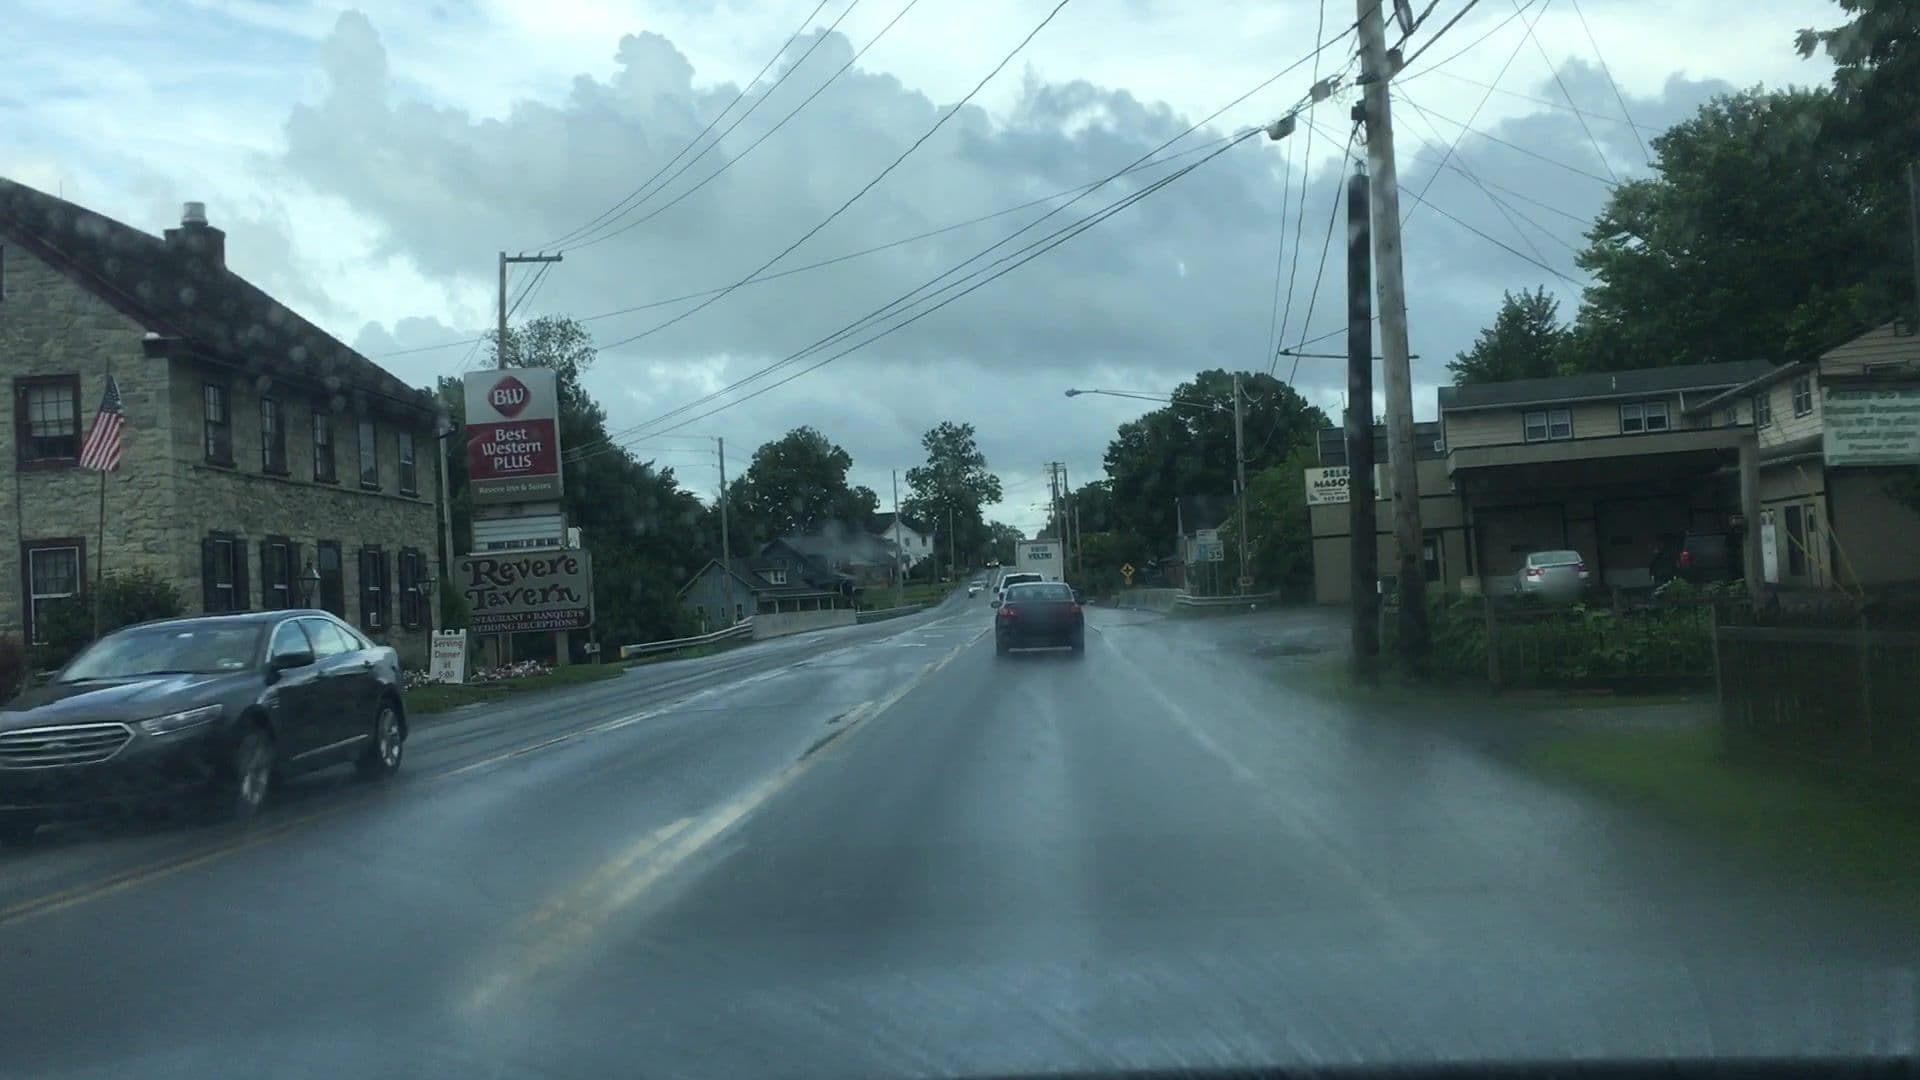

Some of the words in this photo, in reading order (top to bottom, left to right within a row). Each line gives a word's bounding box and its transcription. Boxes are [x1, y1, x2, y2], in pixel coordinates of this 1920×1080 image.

[494, 388, 524, 406] BW
[495, 428, 528, 441] Best
[481, 442, 542, 456] Western
[494, 455, 532, 469] PLUS
[1314, 478, 1347, 488] MASO
[1209, 551, 1223, 560] 35
[462, 554, 578, 588] Revere
[464, 584, 581, 611] Tavern
[472, 613, 525, 625] STAURANT
[533, 609, 585, 621] BANQUETS
[516, 619, 578, 630] RECEPTIONS
[433, 640, 464, 650] Serving
